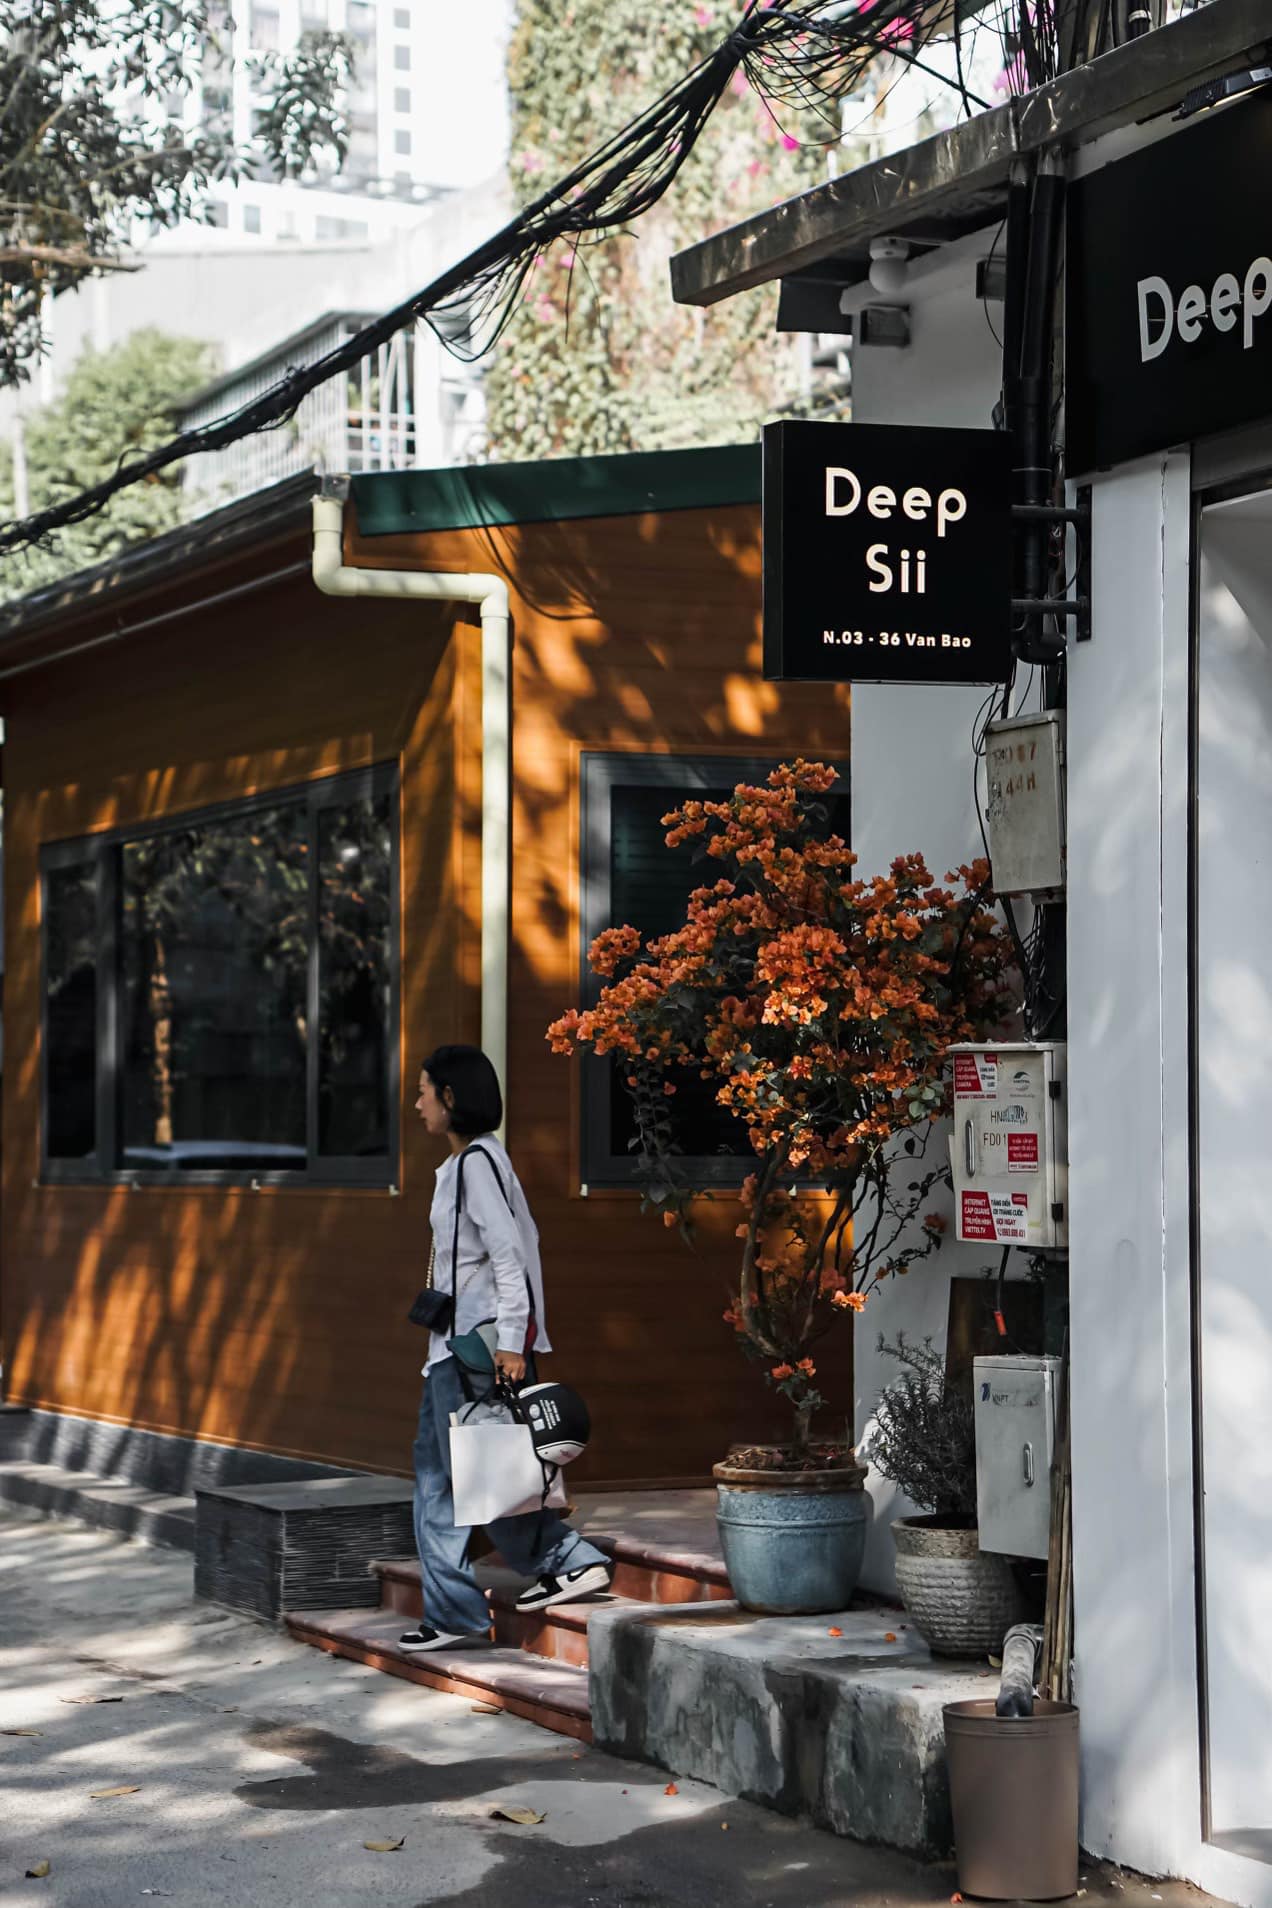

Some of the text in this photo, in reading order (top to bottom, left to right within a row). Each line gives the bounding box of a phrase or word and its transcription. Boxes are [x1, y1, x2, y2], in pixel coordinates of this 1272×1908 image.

[1137, 256, 1272, 363] Deep
[825, 467, 967, 537] Deep
[865, 543, 926, 593] Sii
[823, 630, 863, 645] N.03
[879, 632, 900, 646] 36
[905, 632, 936, 647] Van
[941, 633, 972, 648] Bao
